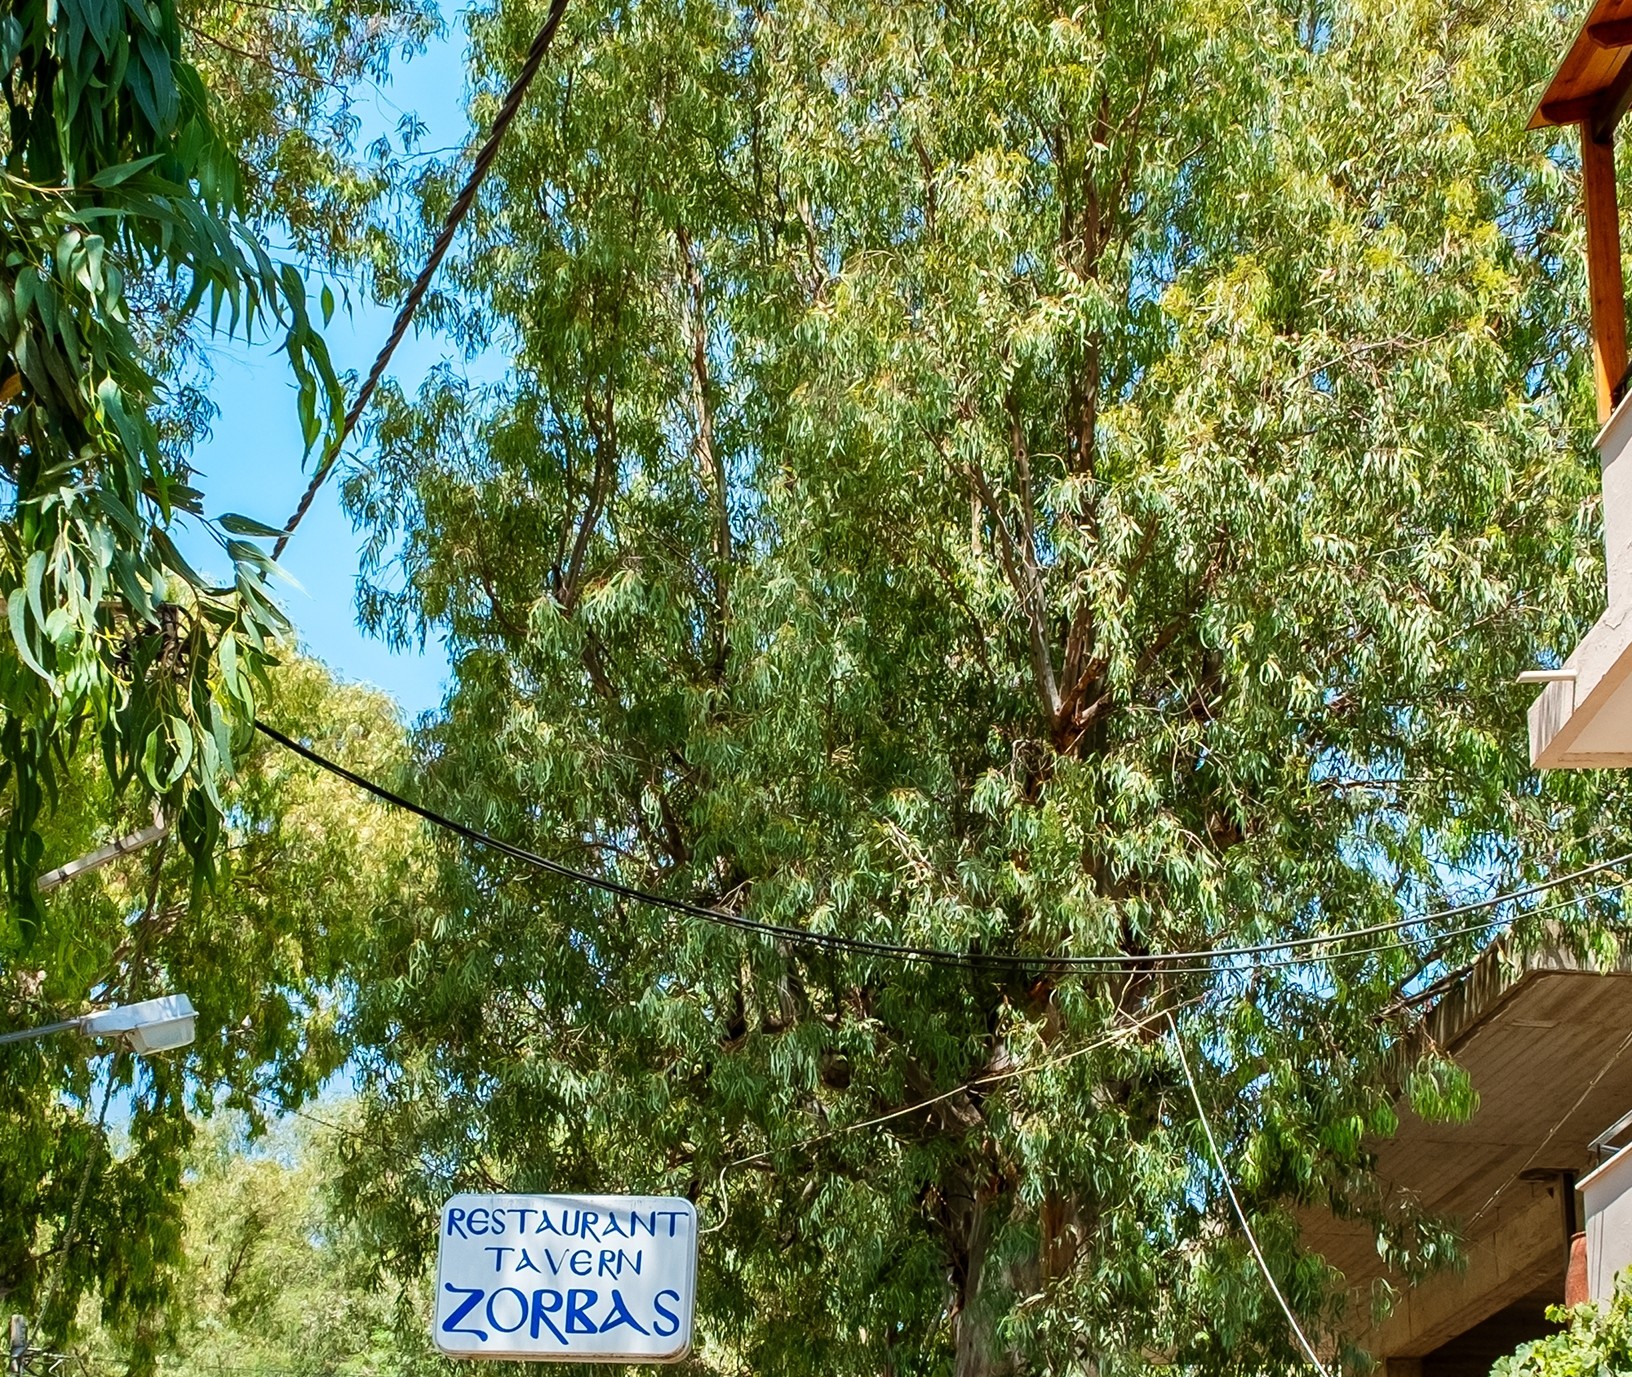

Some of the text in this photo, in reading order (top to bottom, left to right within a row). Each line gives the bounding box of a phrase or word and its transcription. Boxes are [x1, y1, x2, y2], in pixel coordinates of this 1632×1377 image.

[447, 1207, 689, 1243] RESTAURANT
[484, 1247, 643, 1280] TAVERN
[442, 1282, 681, 1346] ZORBAS
